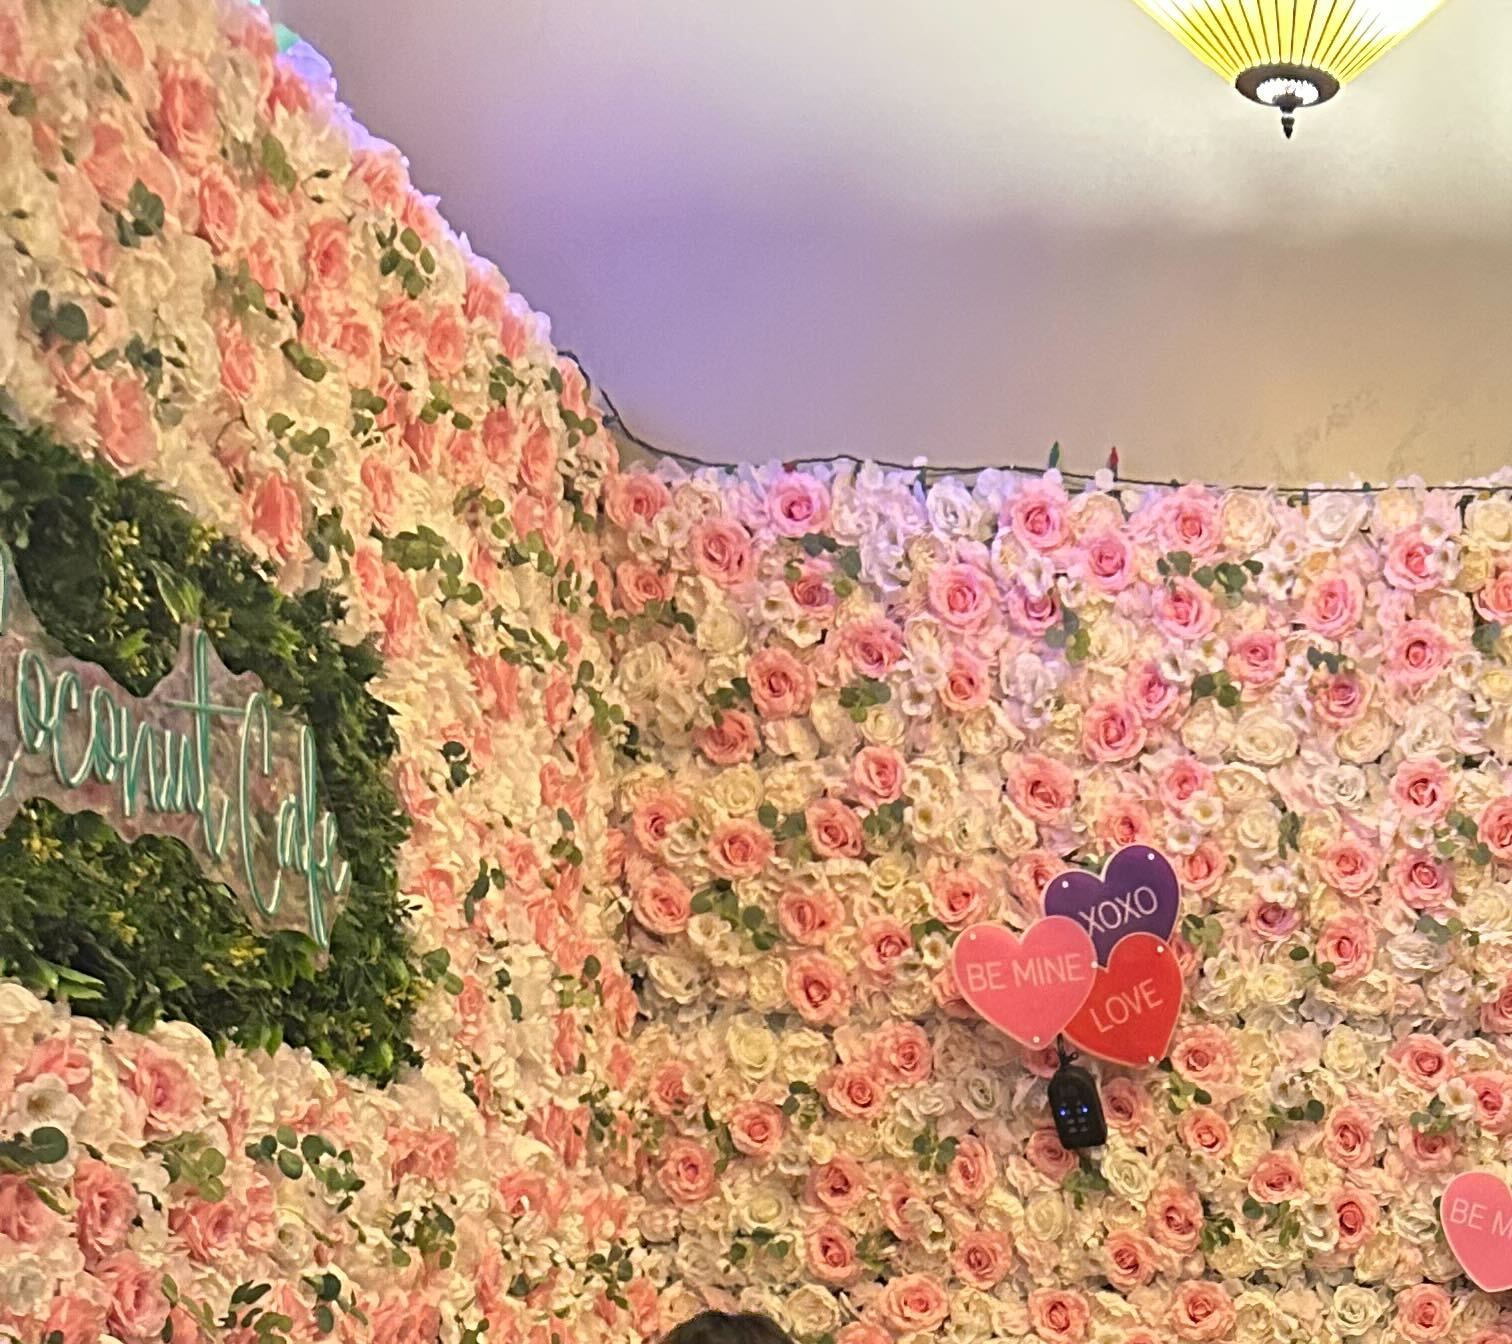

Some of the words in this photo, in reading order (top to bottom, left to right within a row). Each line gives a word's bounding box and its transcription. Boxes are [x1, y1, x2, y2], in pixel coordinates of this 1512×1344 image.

[0, 545, 229, 860] oconut
[1078, 886, 1158, 937] XOXO
[966, 960, 1005, 992] BE
[1012, 953, 1086, 988] MINE
[1089, 978, 1163, 1033] LOVE
[1450, 1199, 1488, 1231] BE
